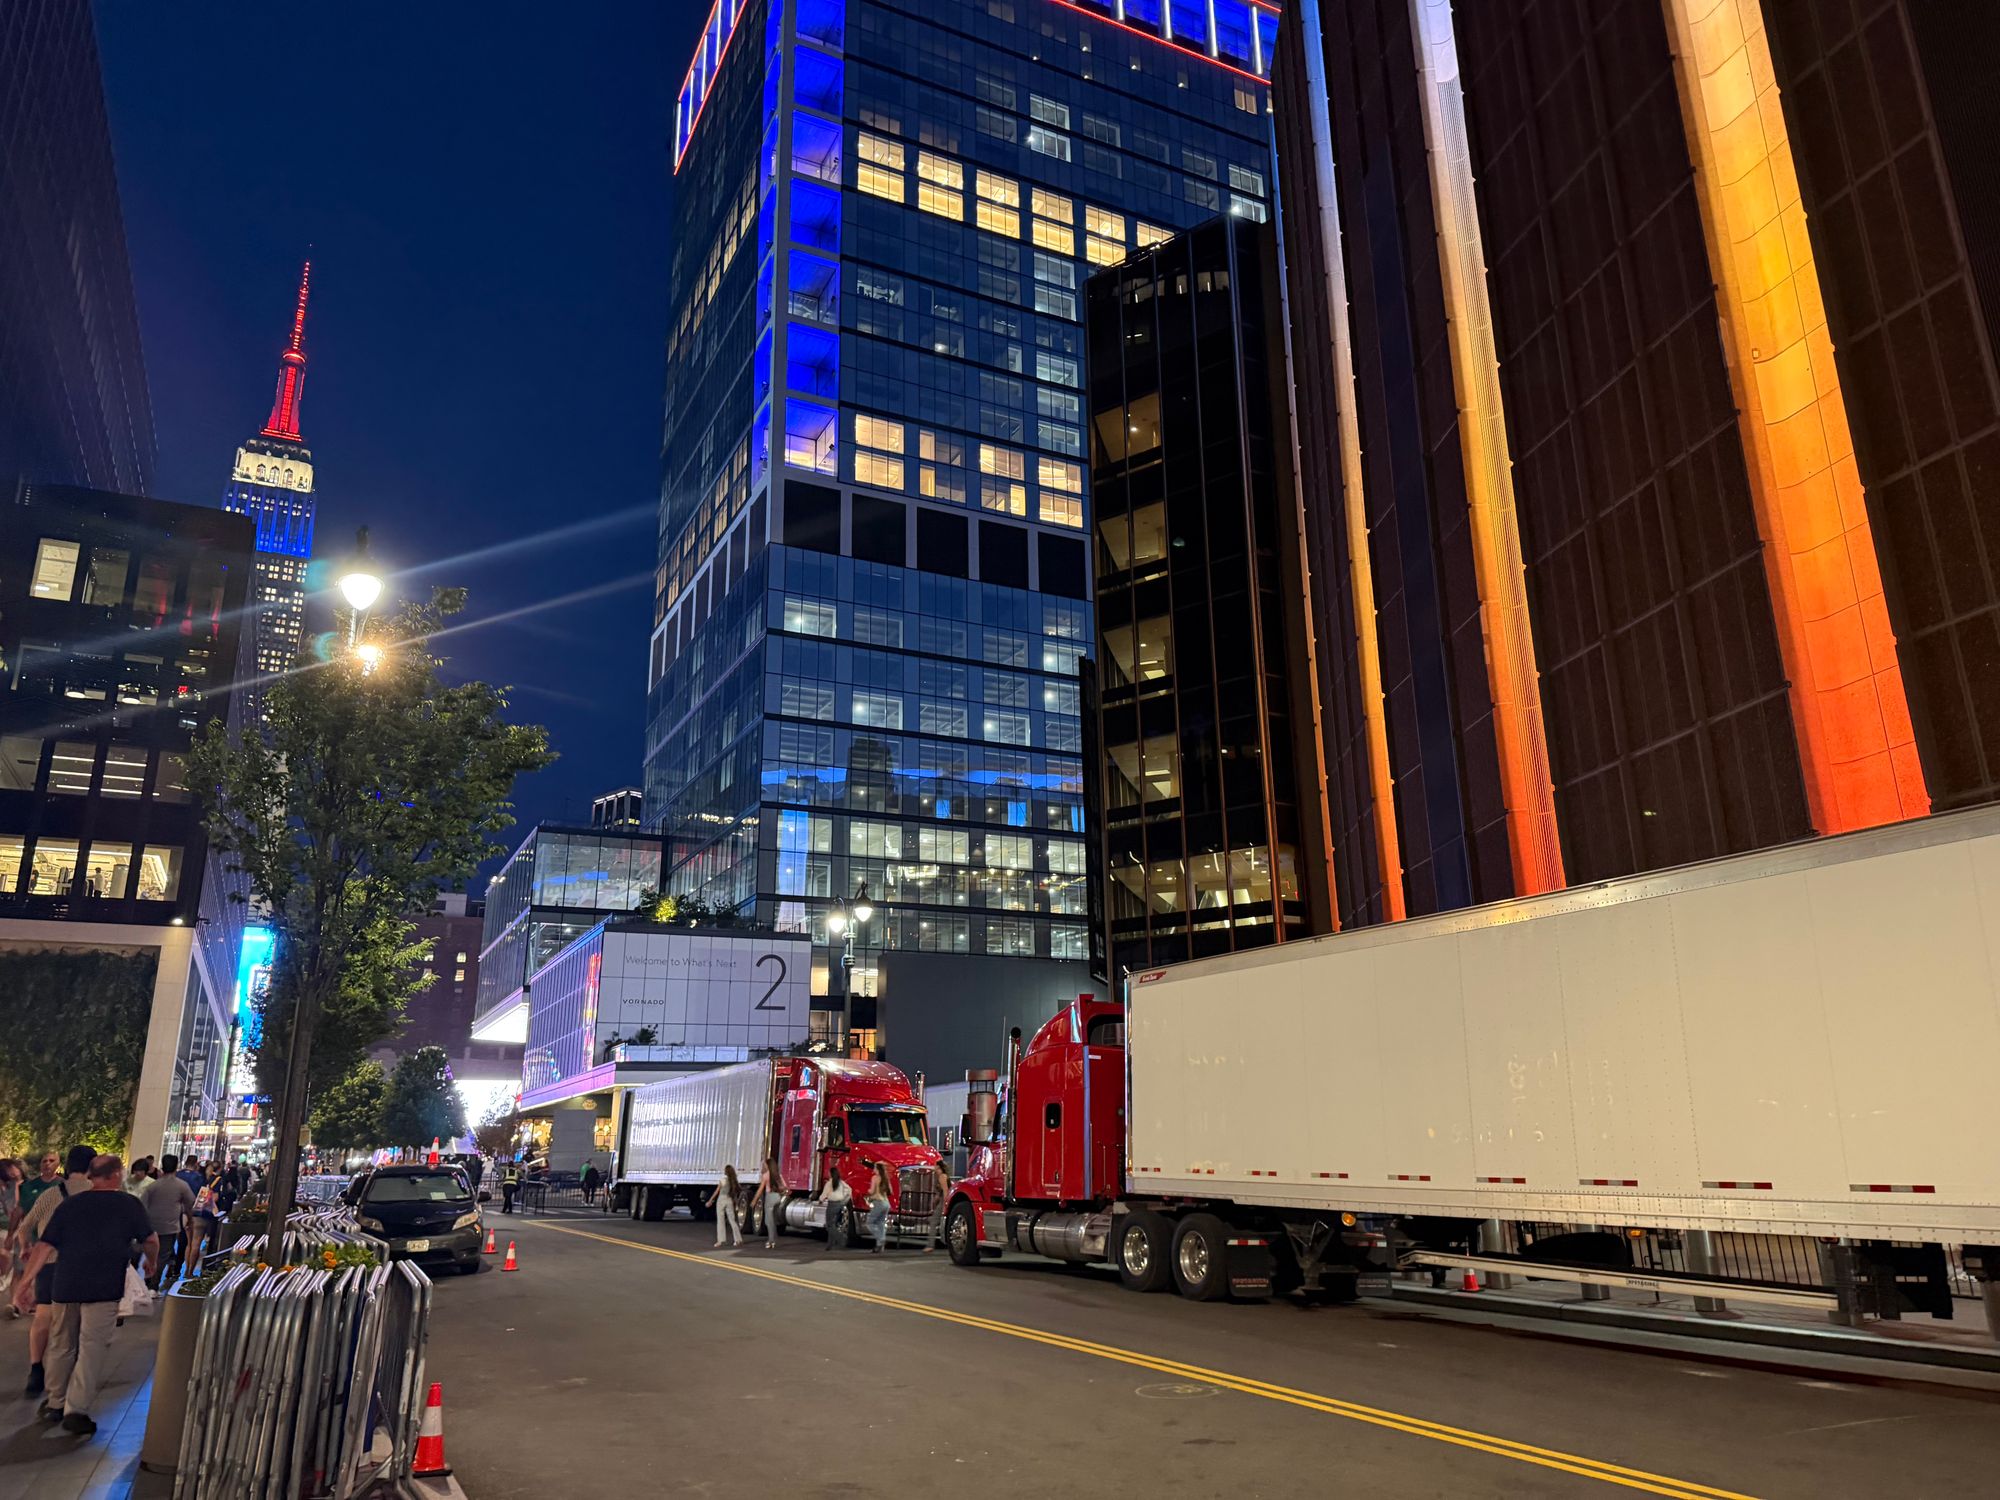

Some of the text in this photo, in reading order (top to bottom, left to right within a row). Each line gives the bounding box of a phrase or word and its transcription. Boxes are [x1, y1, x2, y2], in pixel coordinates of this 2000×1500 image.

[624, 954, 737, 969] Welcome to What's Next
[754, 954, 787, 1011] 2
[622, 998, 665, 1006] VORNADO
